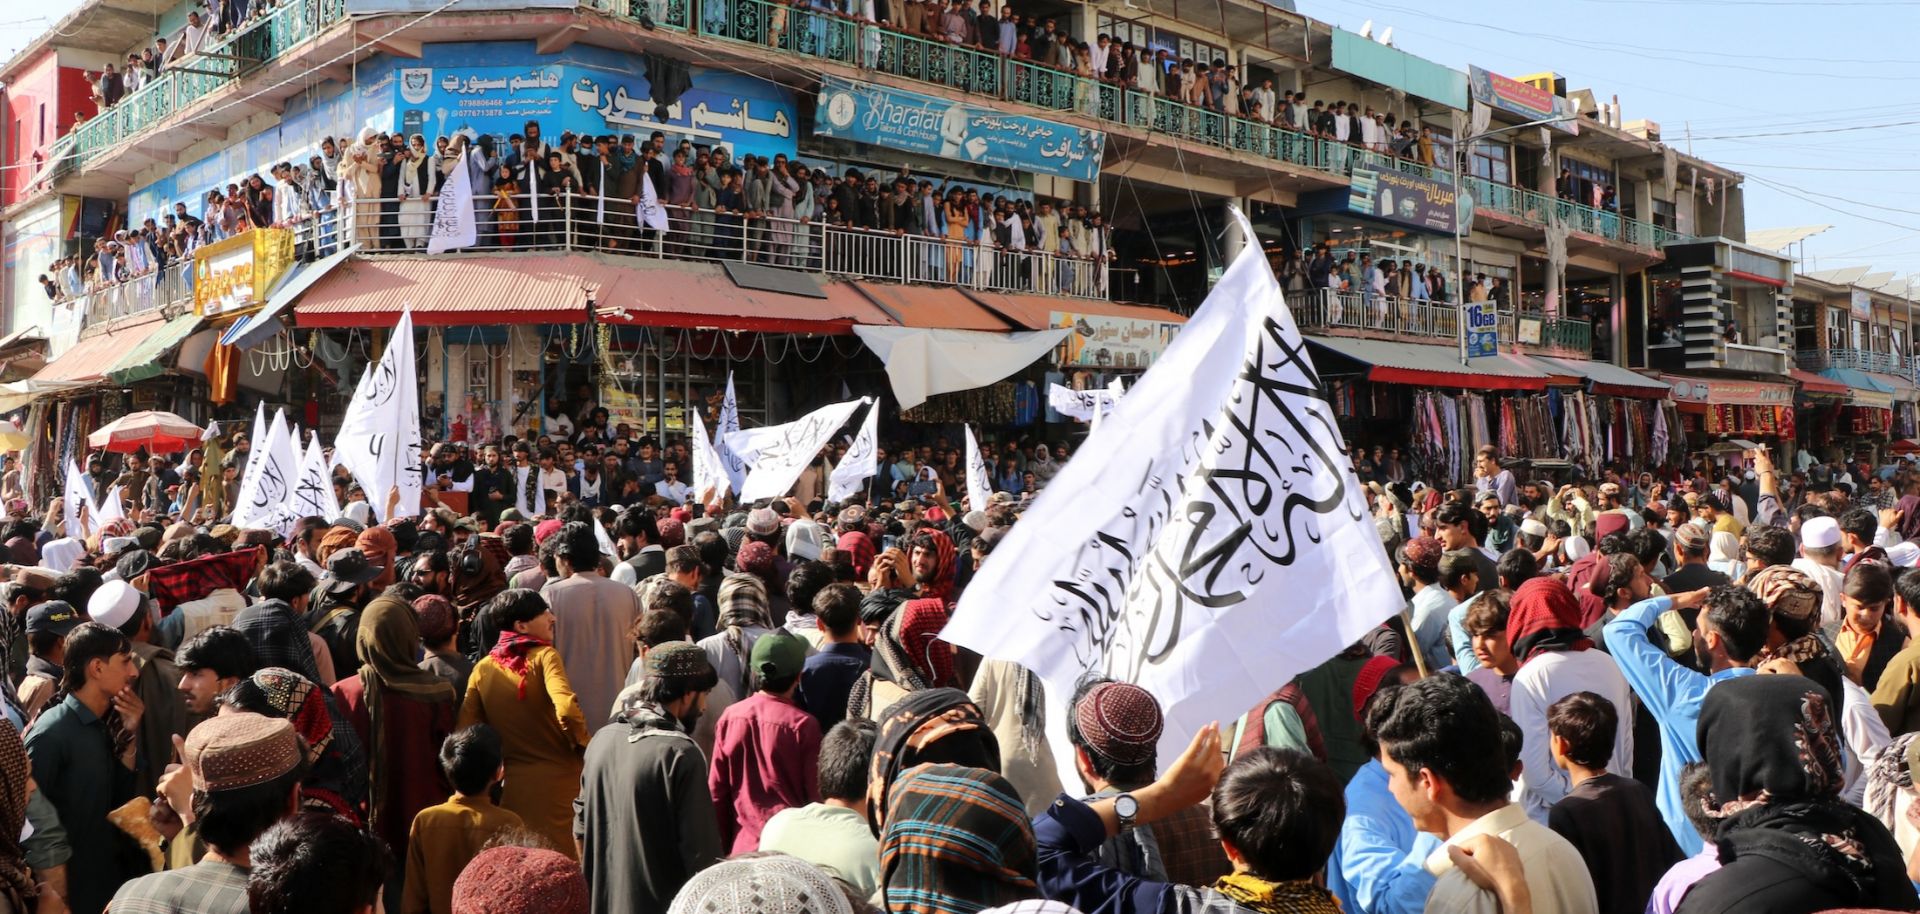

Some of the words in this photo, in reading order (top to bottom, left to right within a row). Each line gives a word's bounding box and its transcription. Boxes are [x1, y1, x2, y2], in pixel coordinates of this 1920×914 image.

[509, 69, 559, 95] هاشم
[689, 97, 790, 138] هاشم
[862, 90, 943, 132] Sharafat
[1040, 136, 1086, 168] شرافت
